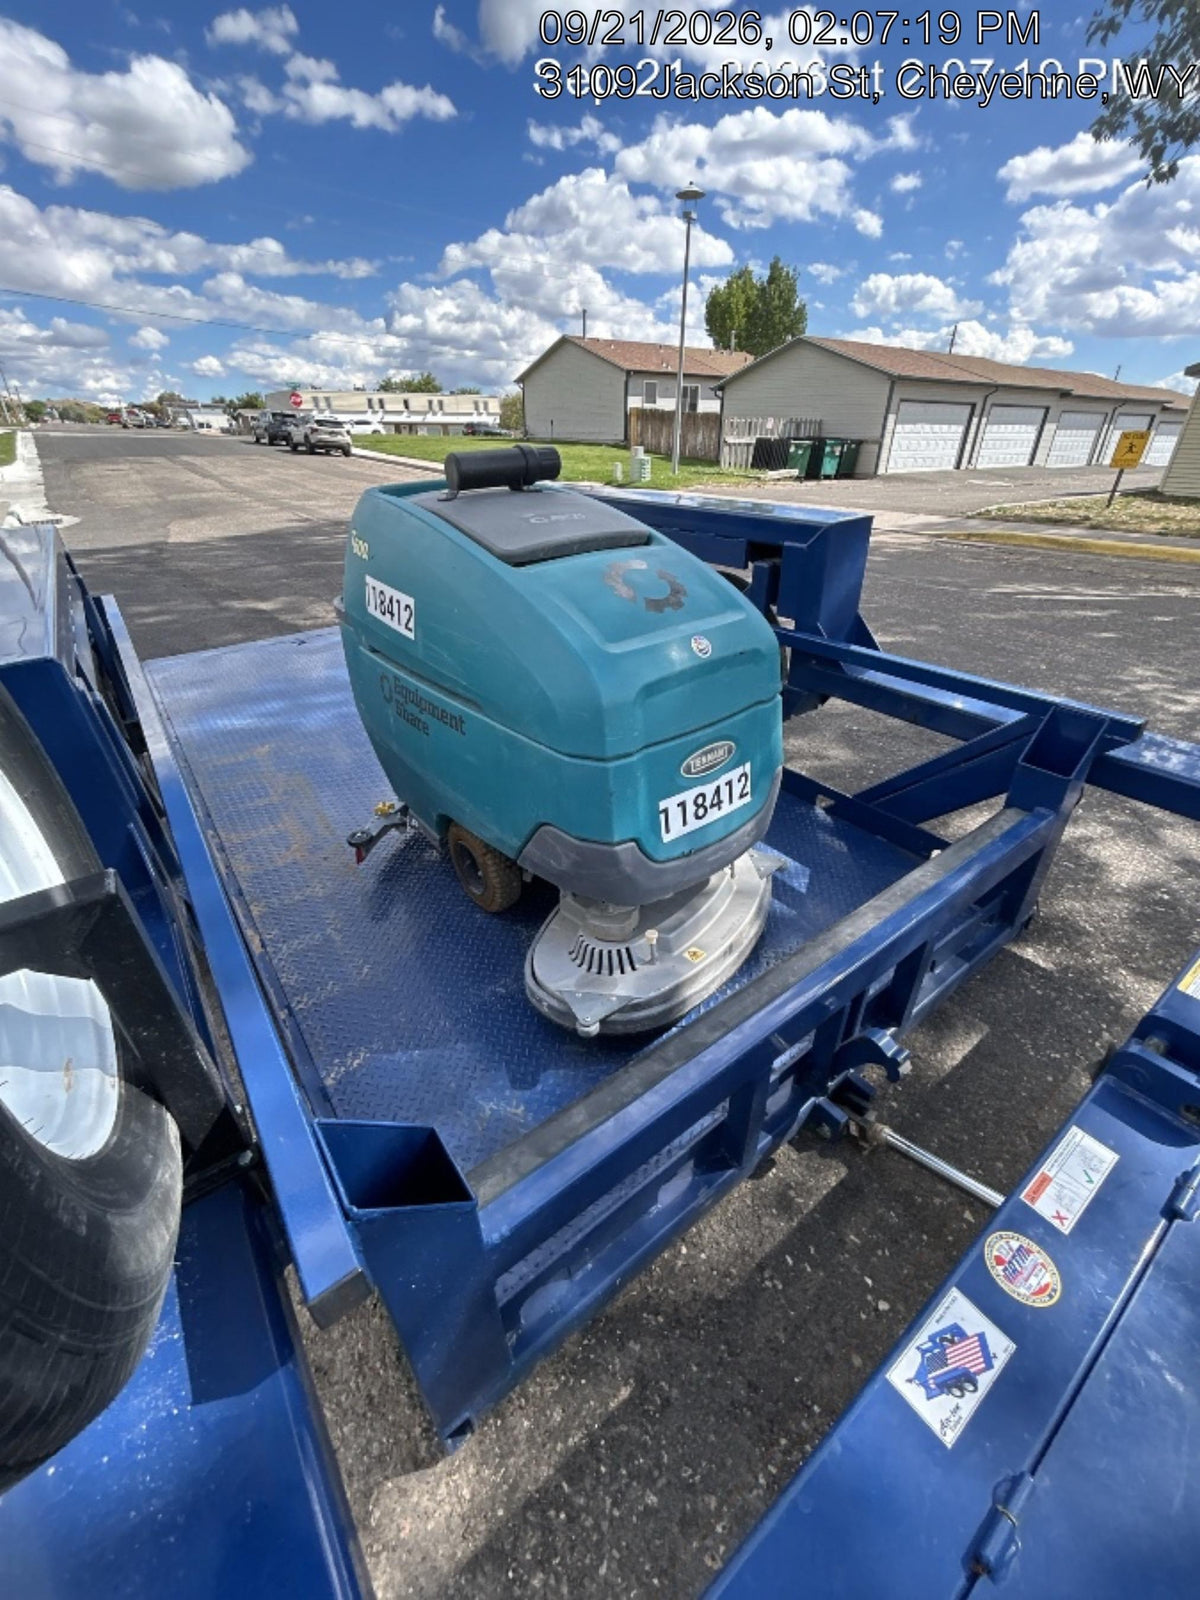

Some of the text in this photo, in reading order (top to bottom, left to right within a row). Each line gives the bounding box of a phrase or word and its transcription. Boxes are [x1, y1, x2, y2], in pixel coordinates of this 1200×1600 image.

[366, 582, 413, 633] 118412
[393, 675, 467, 737] Equipment
[659, 771, 750, 835] 118412
